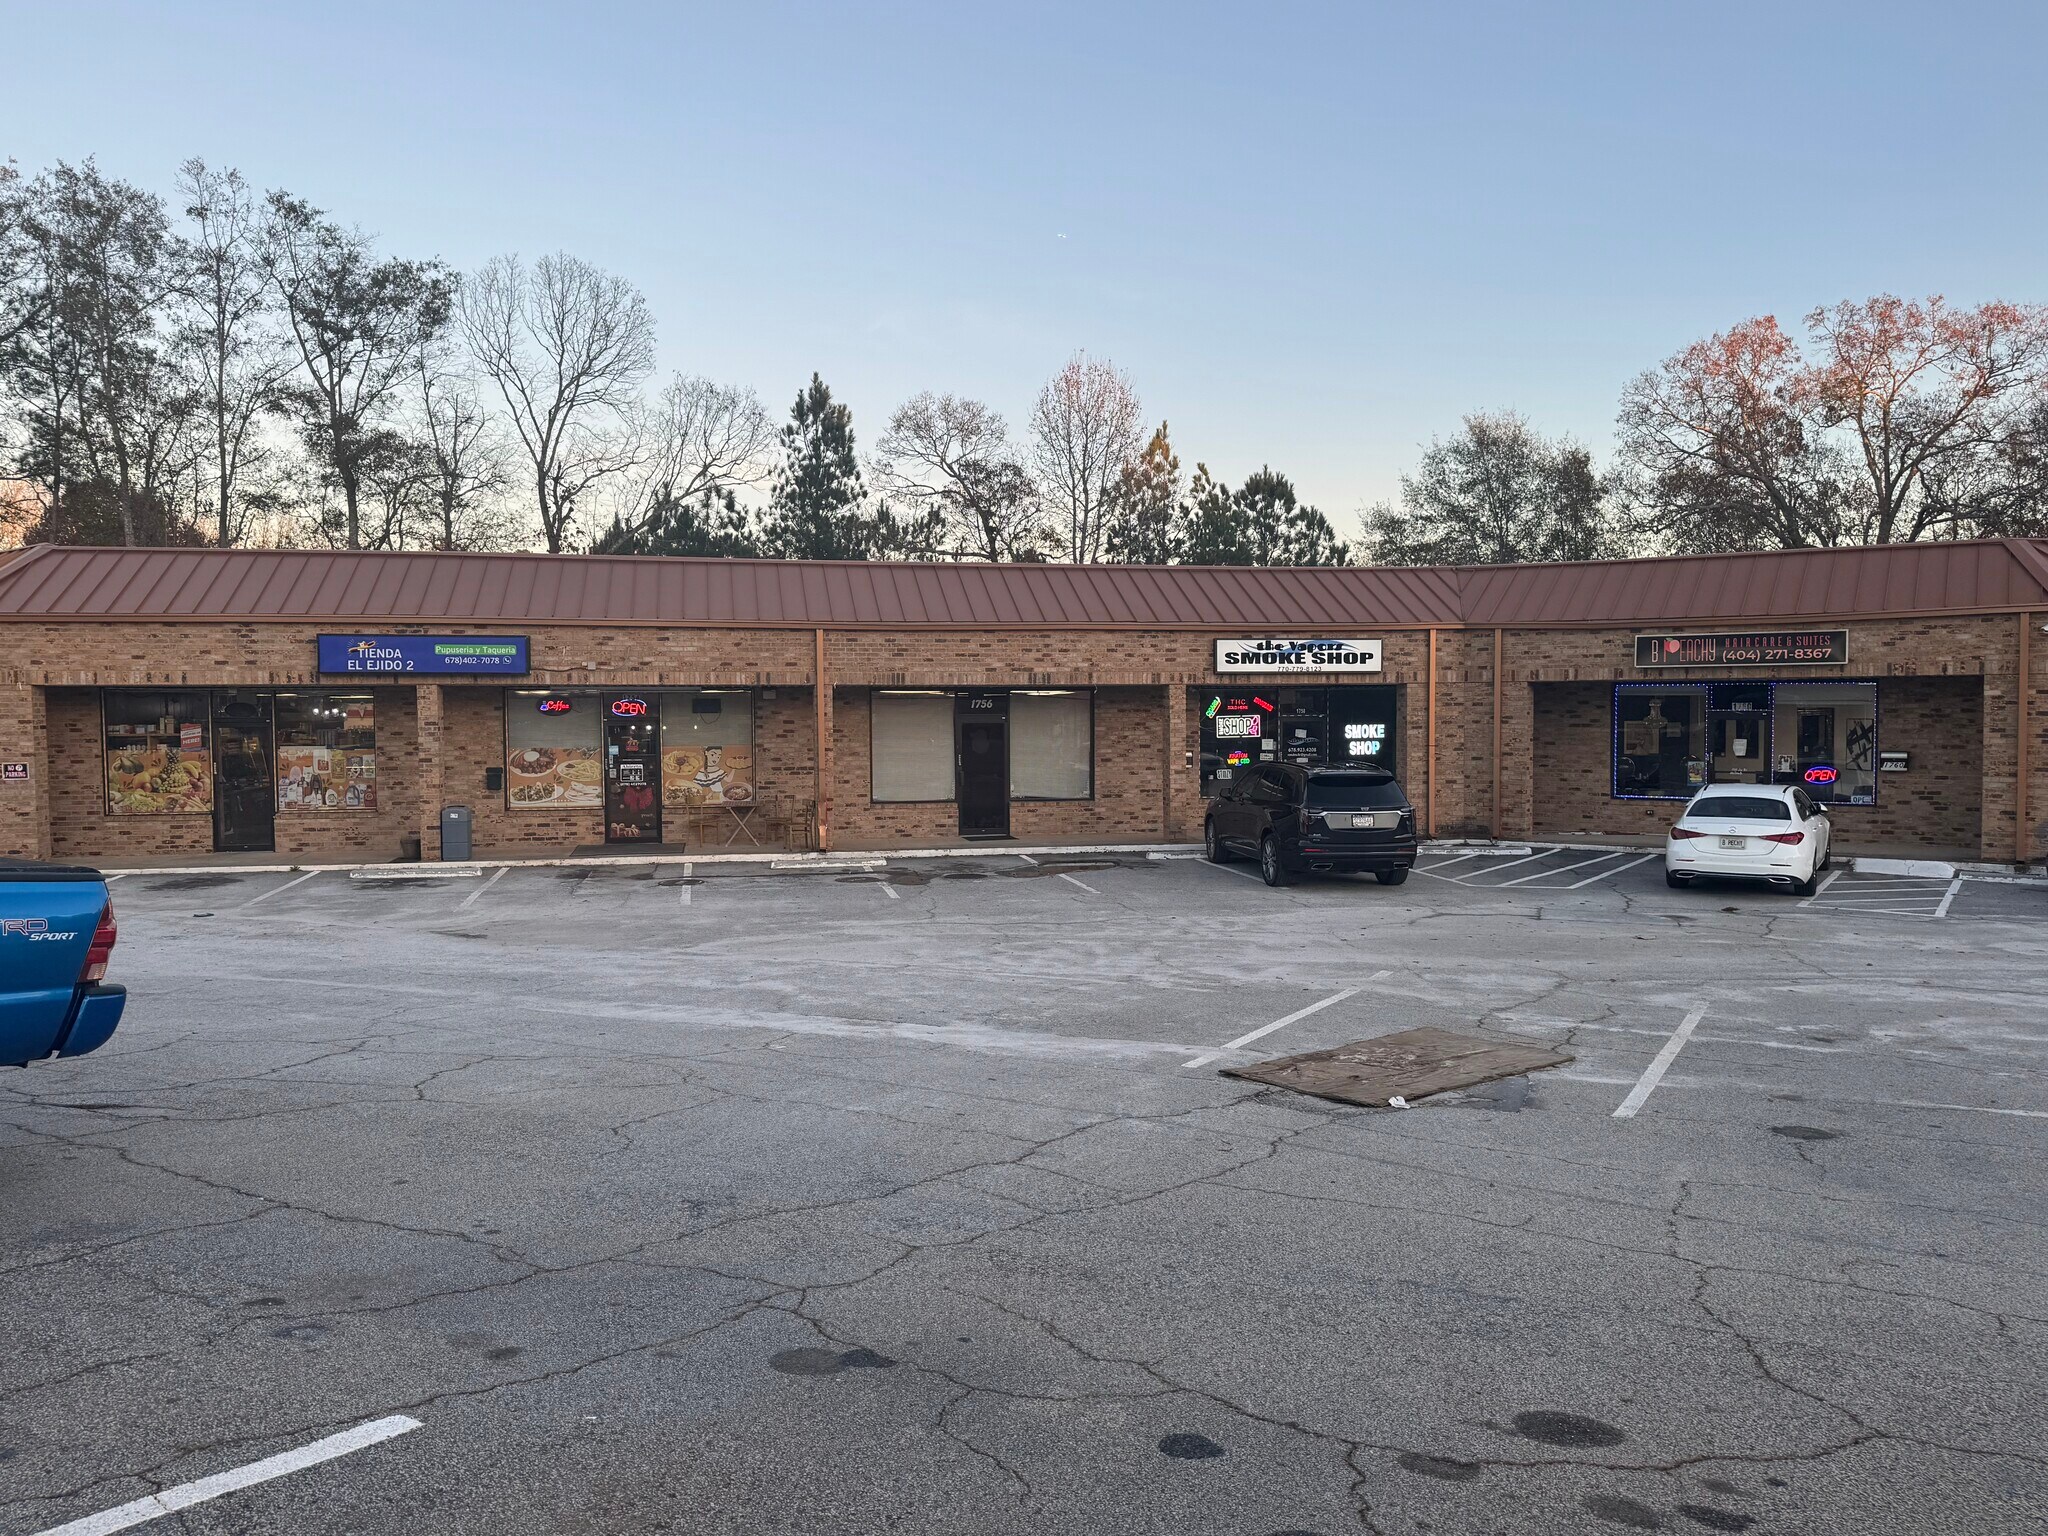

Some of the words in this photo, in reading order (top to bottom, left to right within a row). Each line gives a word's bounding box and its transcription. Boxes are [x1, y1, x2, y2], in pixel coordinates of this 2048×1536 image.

[1256, 640, 1284, 651] the
[1288, 641, 1344, 653] Vapors
[1725, 638, 1750, 648] HAIR
[1754, 636, 1783, 648] CARE
[1796, 635, 1831, 646] SUITES
[358, 648, 402, 659] TIENDA
[435, 645, 474, 655] Pupuseria
[475, 647, 481, 655] y
[482, 646, 516, 655] Taqueria
[1651, 639, 1659, 663] B
[1663, 637, 1716, 663] PEACHY
[1722, 649, 1761, 662] (404)
[1764, 648, 1832, 660] 271-8367
[444, 656, 501, 665] 678)402-7078
[1224, 652, 1306, 665] SMOKE
[1311, 652, 1374, 665] SHOP
[347, 660, 363, 671] EL
[367, 660, 403, 671] EJIDO
[406, 660, 415, 671] 2
[547, 701, 570, 711] Coffee
[612, 701, 647, 715] OPEN
[970, 699, 993, 709] 1756
[1224, 718, 1252, 735] SHOP
[1344, 724, 1386, 739] SMOKE
[1349, 740, 1381, 756] SHOP
[1804, 769, 1837, 781] OPEN
[29, 932, 79, 941] SPORT
